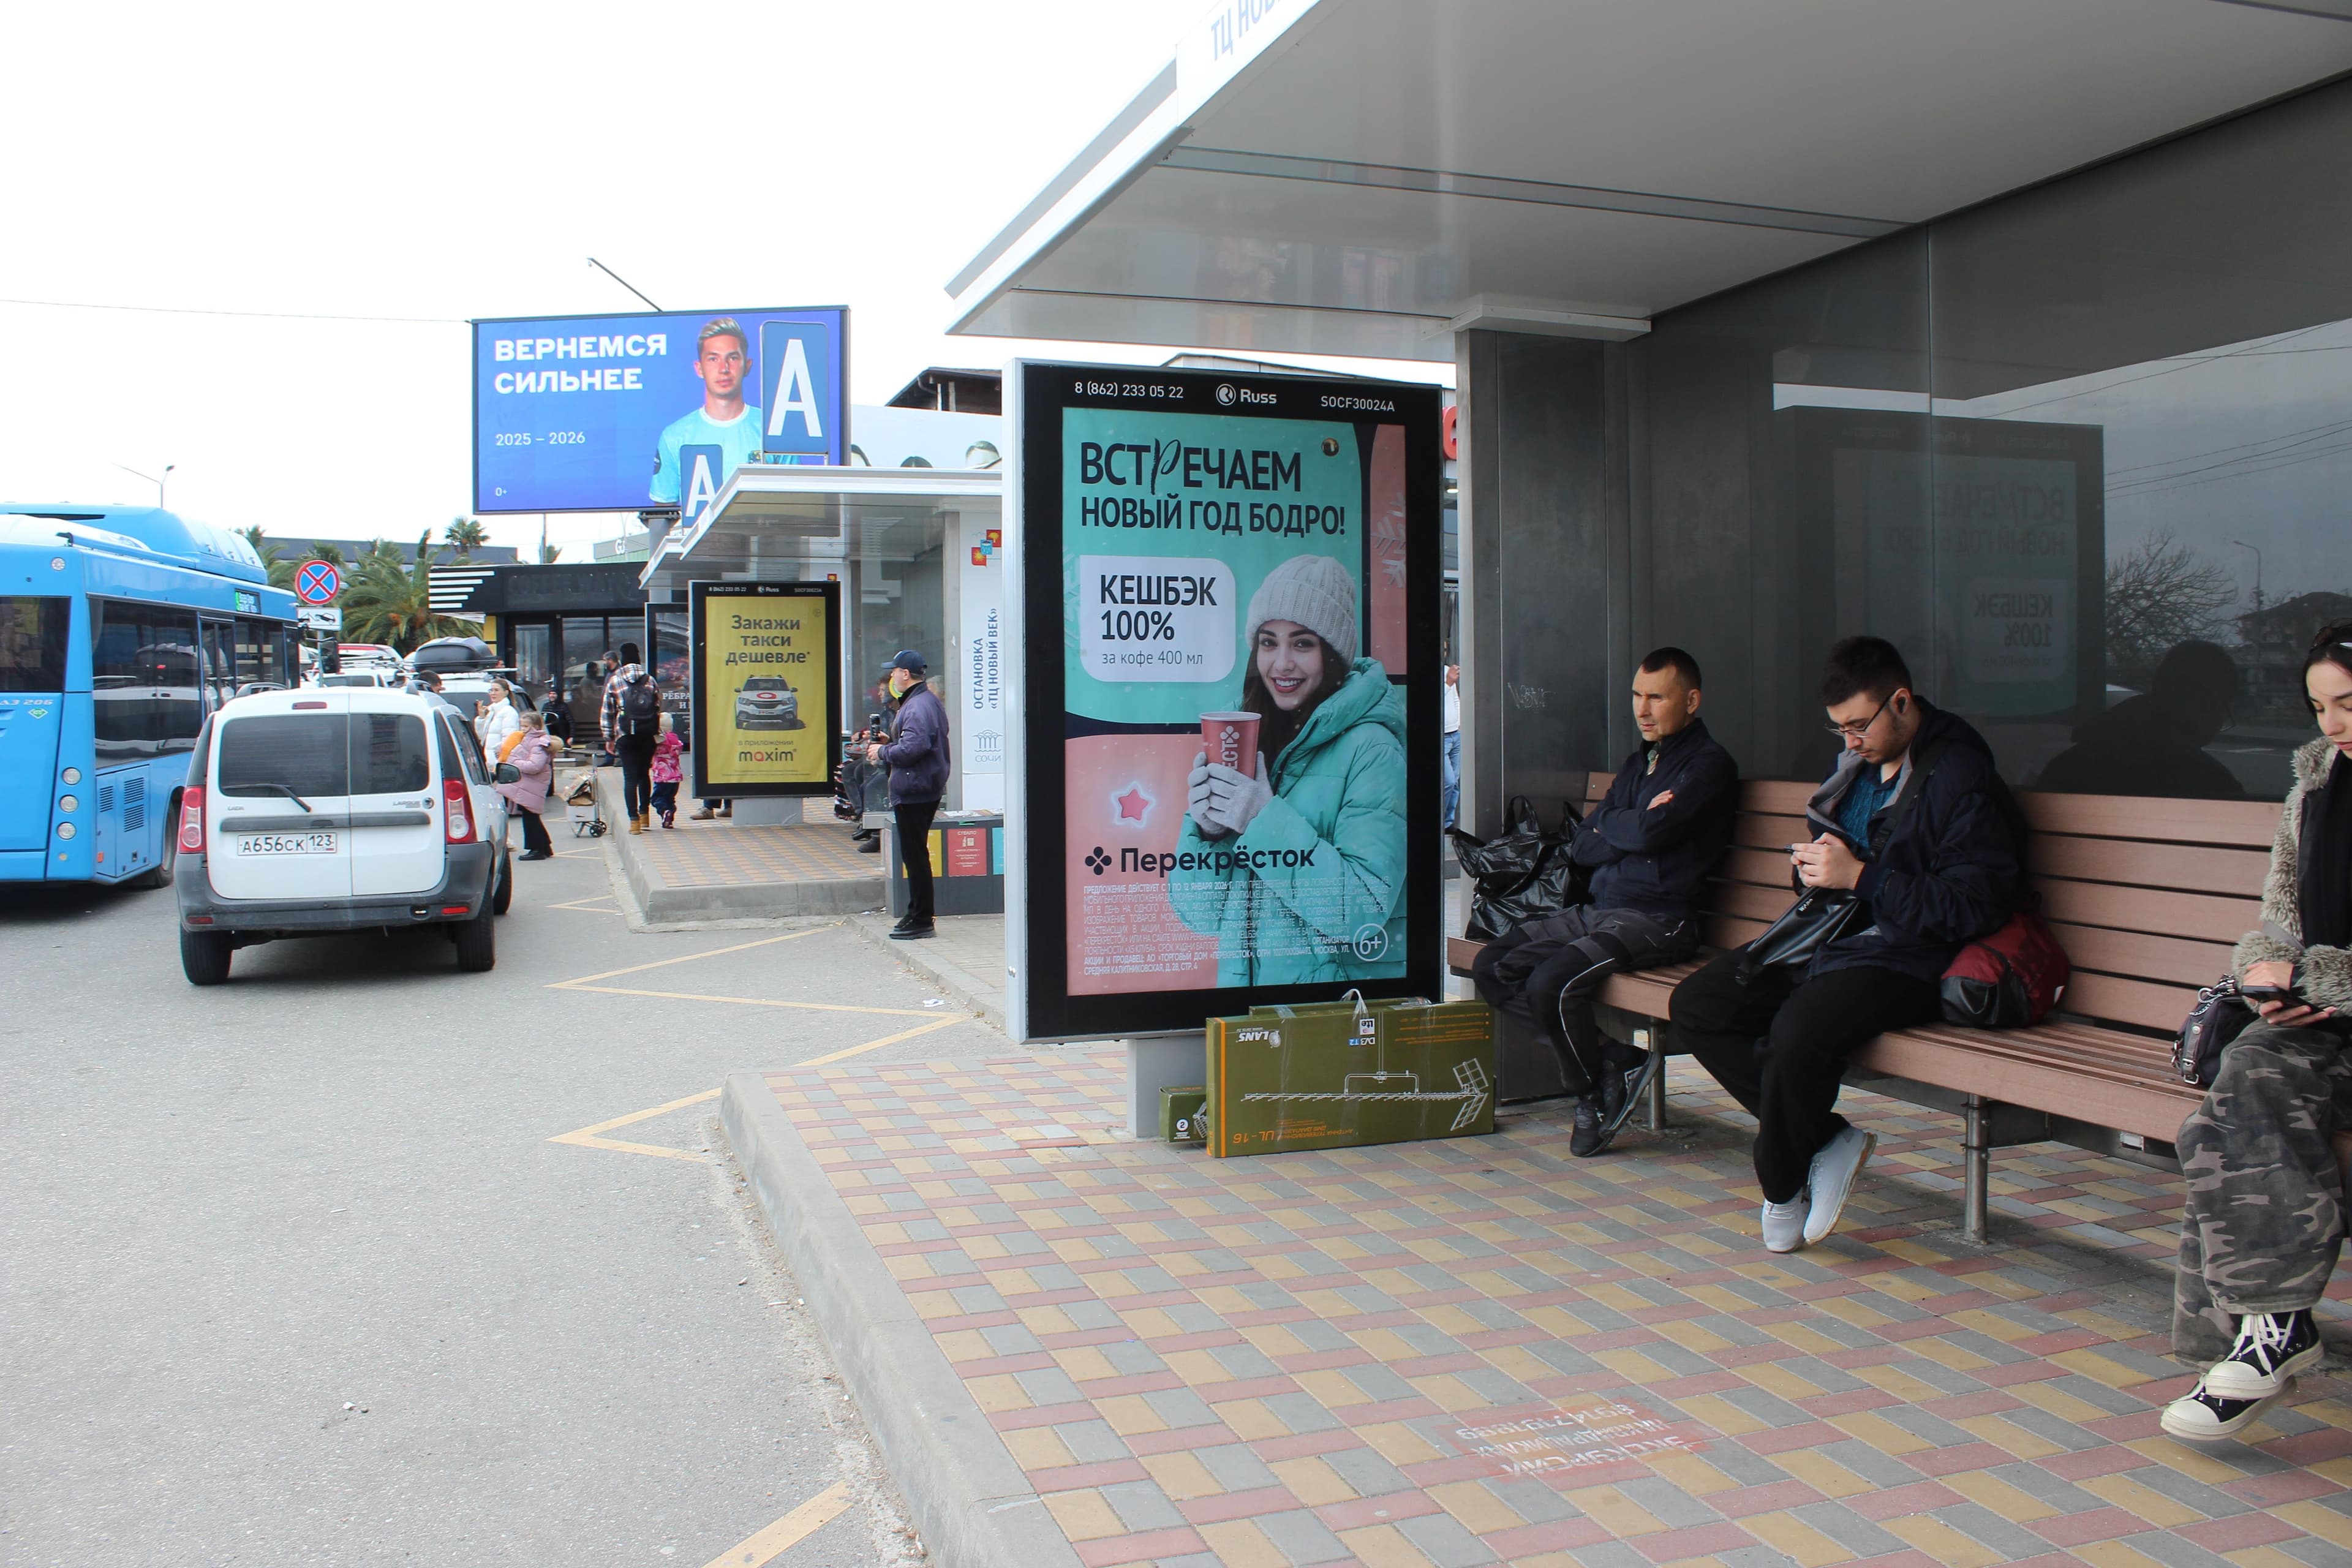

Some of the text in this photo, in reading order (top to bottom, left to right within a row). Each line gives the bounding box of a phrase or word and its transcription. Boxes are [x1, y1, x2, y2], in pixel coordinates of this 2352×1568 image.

[1211, 8, 1233, 61] ТЦ
[494, 334, 667, 362] ВЕРНЕМСЯ
[494, 368, 643, 394] СИЛЬНЕЕ
[767, 338, 823, 437] А
[1074, 381, 1184, 399] 8 (862) 233 05 22
[1240, 388, 1277, 404] Russ
[1321, 395, 1395, 412] SOCF30024A
[496, 432, 532, 446] 2025
[549, 431, 586, 445] 2026
[1080, 438, 1301, 496] ВСТРЕЧАЕМ
[495, 487, 508, 497] 0+
[1080, 492, 1346, 540] НОВЫЙ ГОД БОДРО!
[1100, 574, 1217, 606] КЕШБЭК
[731, 614, 801, 631] Закажи
[1101, 610, 1175, 641] 100%
[741, 633, 792, 647] такси
[986, 608, 1000, 709] «ТЦ НОВЫЙ ВЕК»
[1102, 650, 1204, 669] за кофе 400 мл
[973, 638, 984, 709] ОСТАНОВКА
[662, 691, 690, 699] РЁБРА
[739, 748, 794, 762] maxim
[242, 835, 332, 853] А656СК 123
[1120, 845, 1315, 876] Перекрёсток
[1084, 885, 1126, 894] ПРЕДЛОЖЕНИЕ
[1128, 883, 1159, 893] ДЕЙСТВУЕТ
[1312, 935, 1350, 944] ОРГАНИЗАТОР
[1359, 930, 1382, 955] 6+
[1084, 956, 1104, 966] АКЦИИ
[1158, 951, 1192, 962] «ТОРГОВЫЙ
[1194, 951, 1207, 961] ДОМ
[1084, 966, 1110, 976] СРЕДНЯЯ
[1180, 962, 1193, 971] СТР.
[1238, 1031, 1269, 1042] LANS
[1499, 1435, 1686, 1476] ЭКСКУРСИИ
